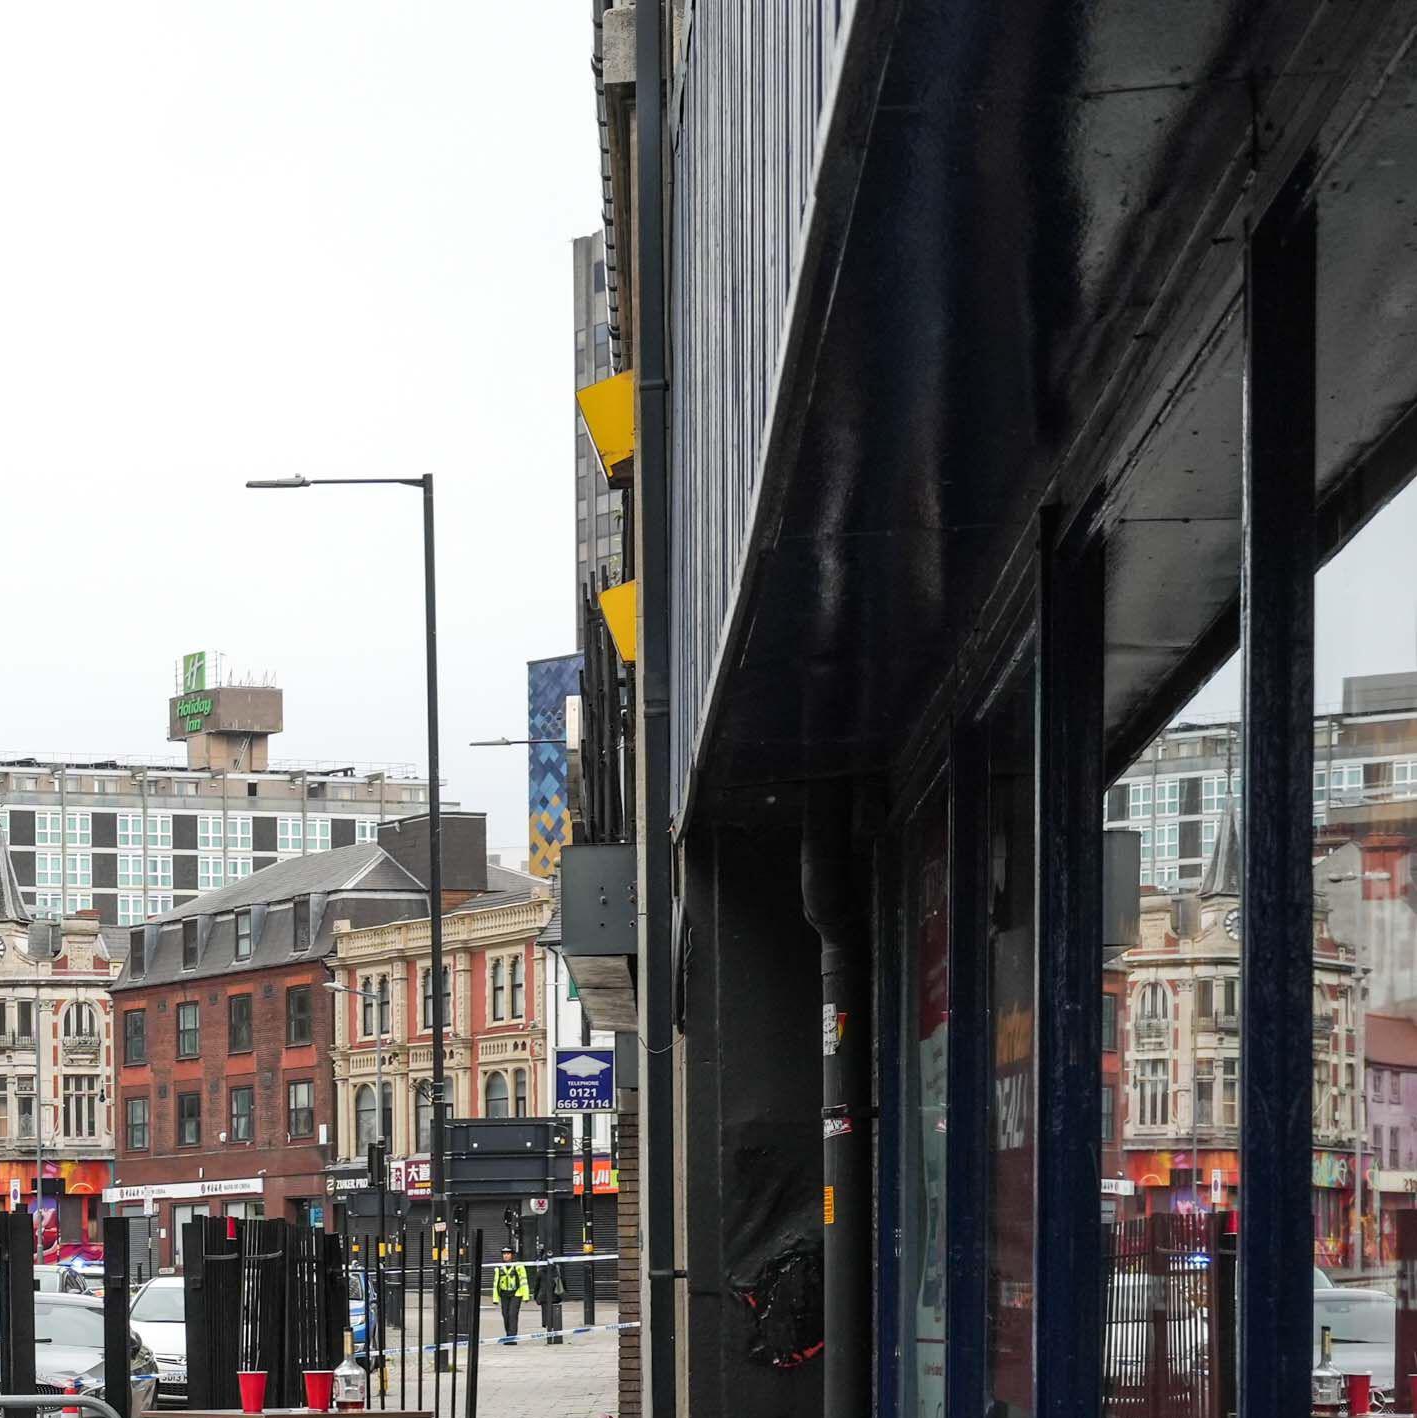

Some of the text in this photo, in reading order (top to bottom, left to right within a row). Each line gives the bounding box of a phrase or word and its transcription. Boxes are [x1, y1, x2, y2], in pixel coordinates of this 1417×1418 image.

[177, 697, 213, 717] Holiday
[186, 715, 202, 733] Inn
[569, 1088, 597, 1097] 0121
[557, 1100, 610, 1109] 666 7114
